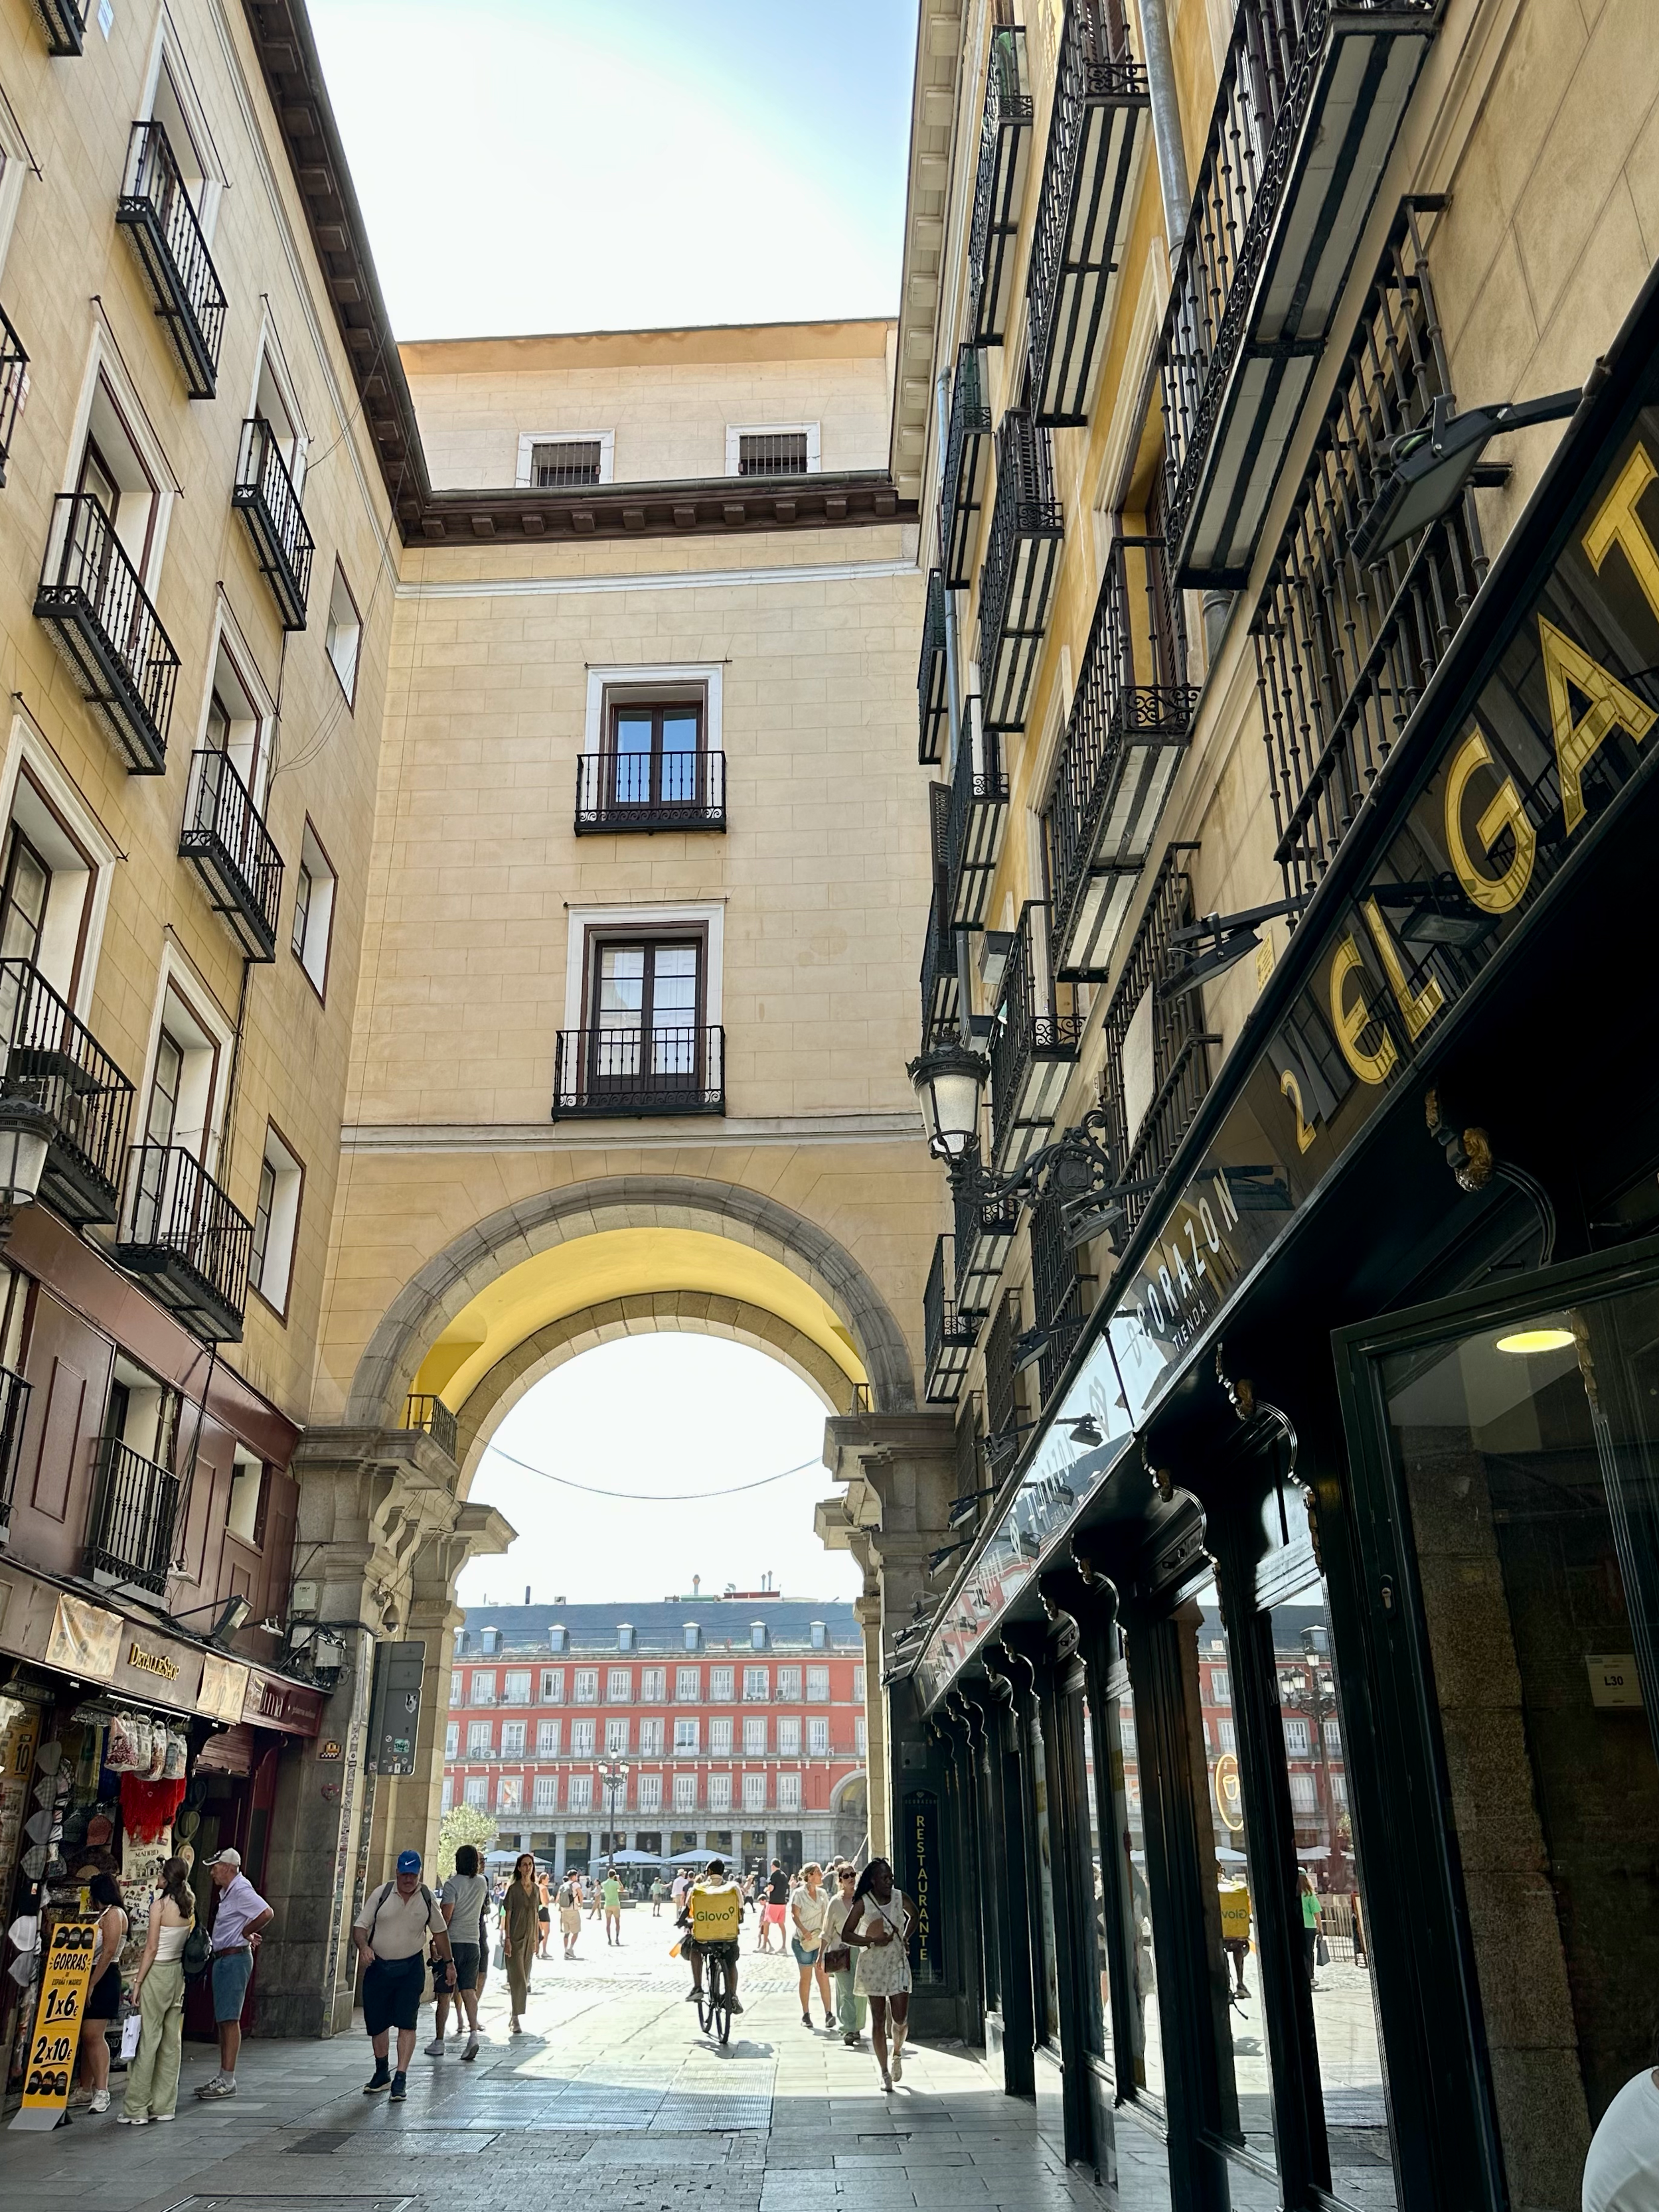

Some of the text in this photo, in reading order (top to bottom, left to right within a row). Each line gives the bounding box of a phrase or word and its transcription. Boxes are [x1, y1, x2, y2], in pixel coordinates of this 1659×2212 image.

[1172, 1299, 1207, 1352] TIENDA
[1604, 1675, 1624, 1686] L30
[916, 1815, 929, 1961] RESTAURANTE
[696, 1911, 730, 1921] Glovo
